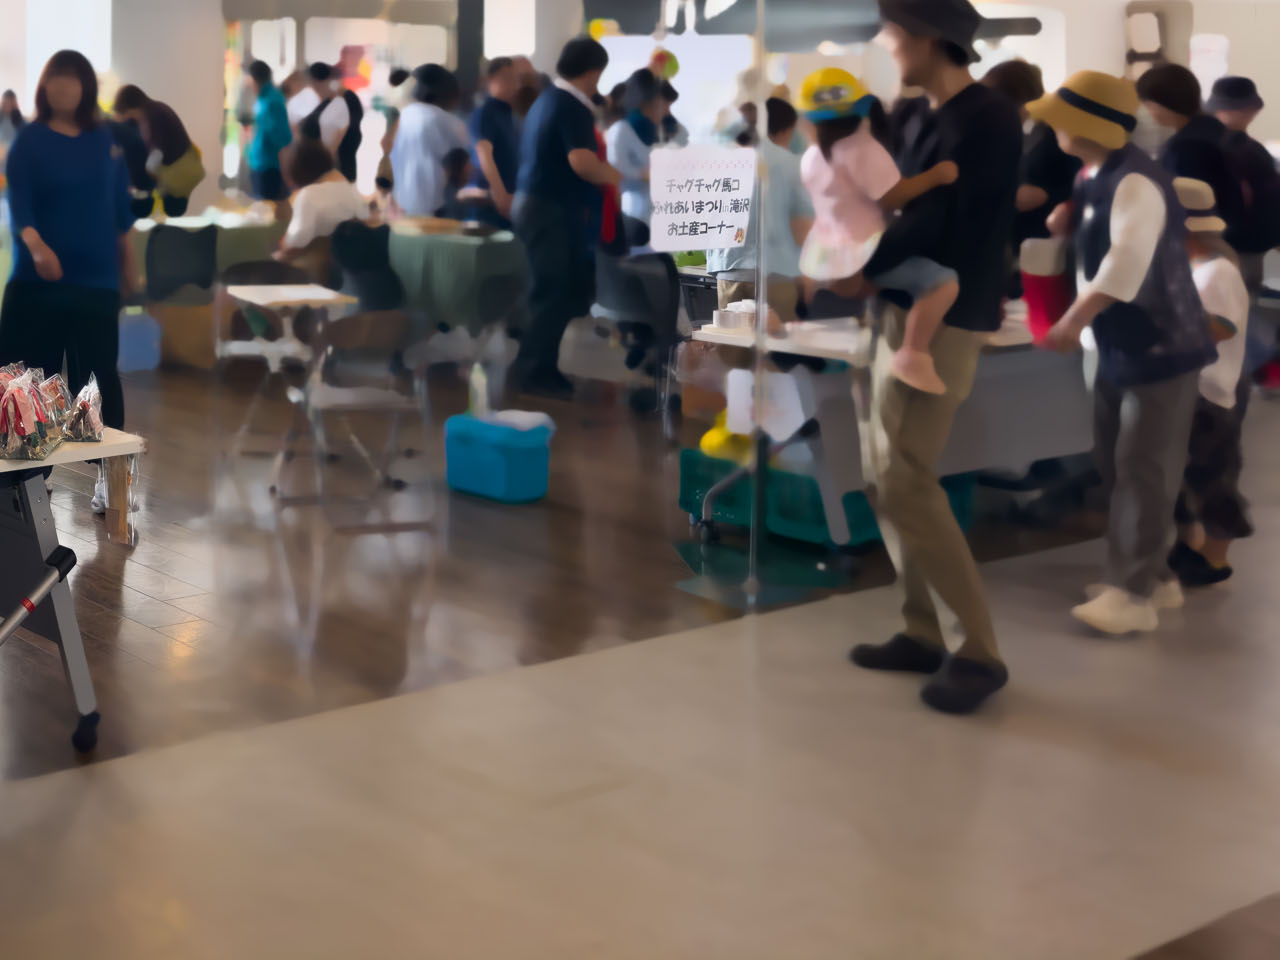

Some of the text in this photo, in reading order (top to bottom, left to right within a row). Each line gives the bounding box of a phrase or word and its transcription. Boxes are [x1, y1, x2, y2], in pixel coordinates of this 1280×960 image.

[666, 177, 740, 193] チャグチャグ馬コ
[667, 220, 735, 237] お土産コーナー
